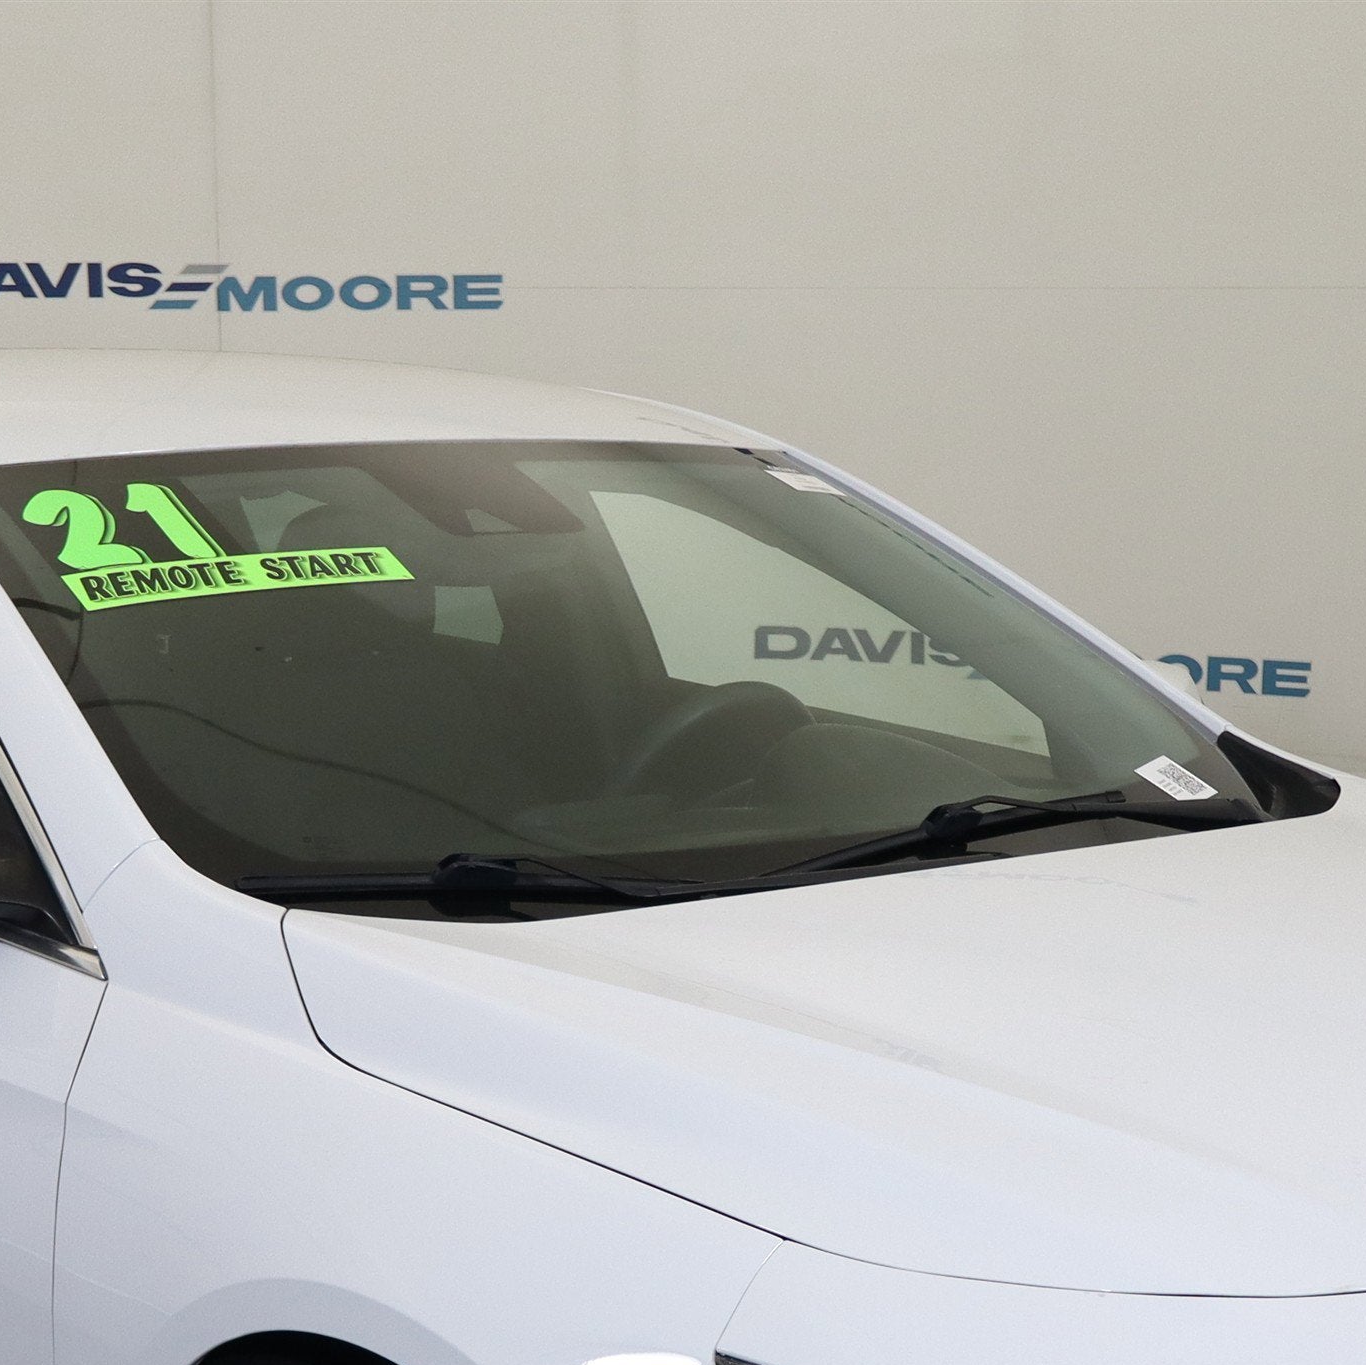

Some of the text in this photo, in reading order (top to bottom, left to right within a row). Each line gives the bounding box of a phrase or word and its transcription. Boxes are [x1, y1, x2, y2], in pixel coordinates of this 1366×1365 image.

[215, 273, 504, 312] MOORE
[21, 482, 223, 568] 21
[79, 550, 381, 602] REMOTE START
